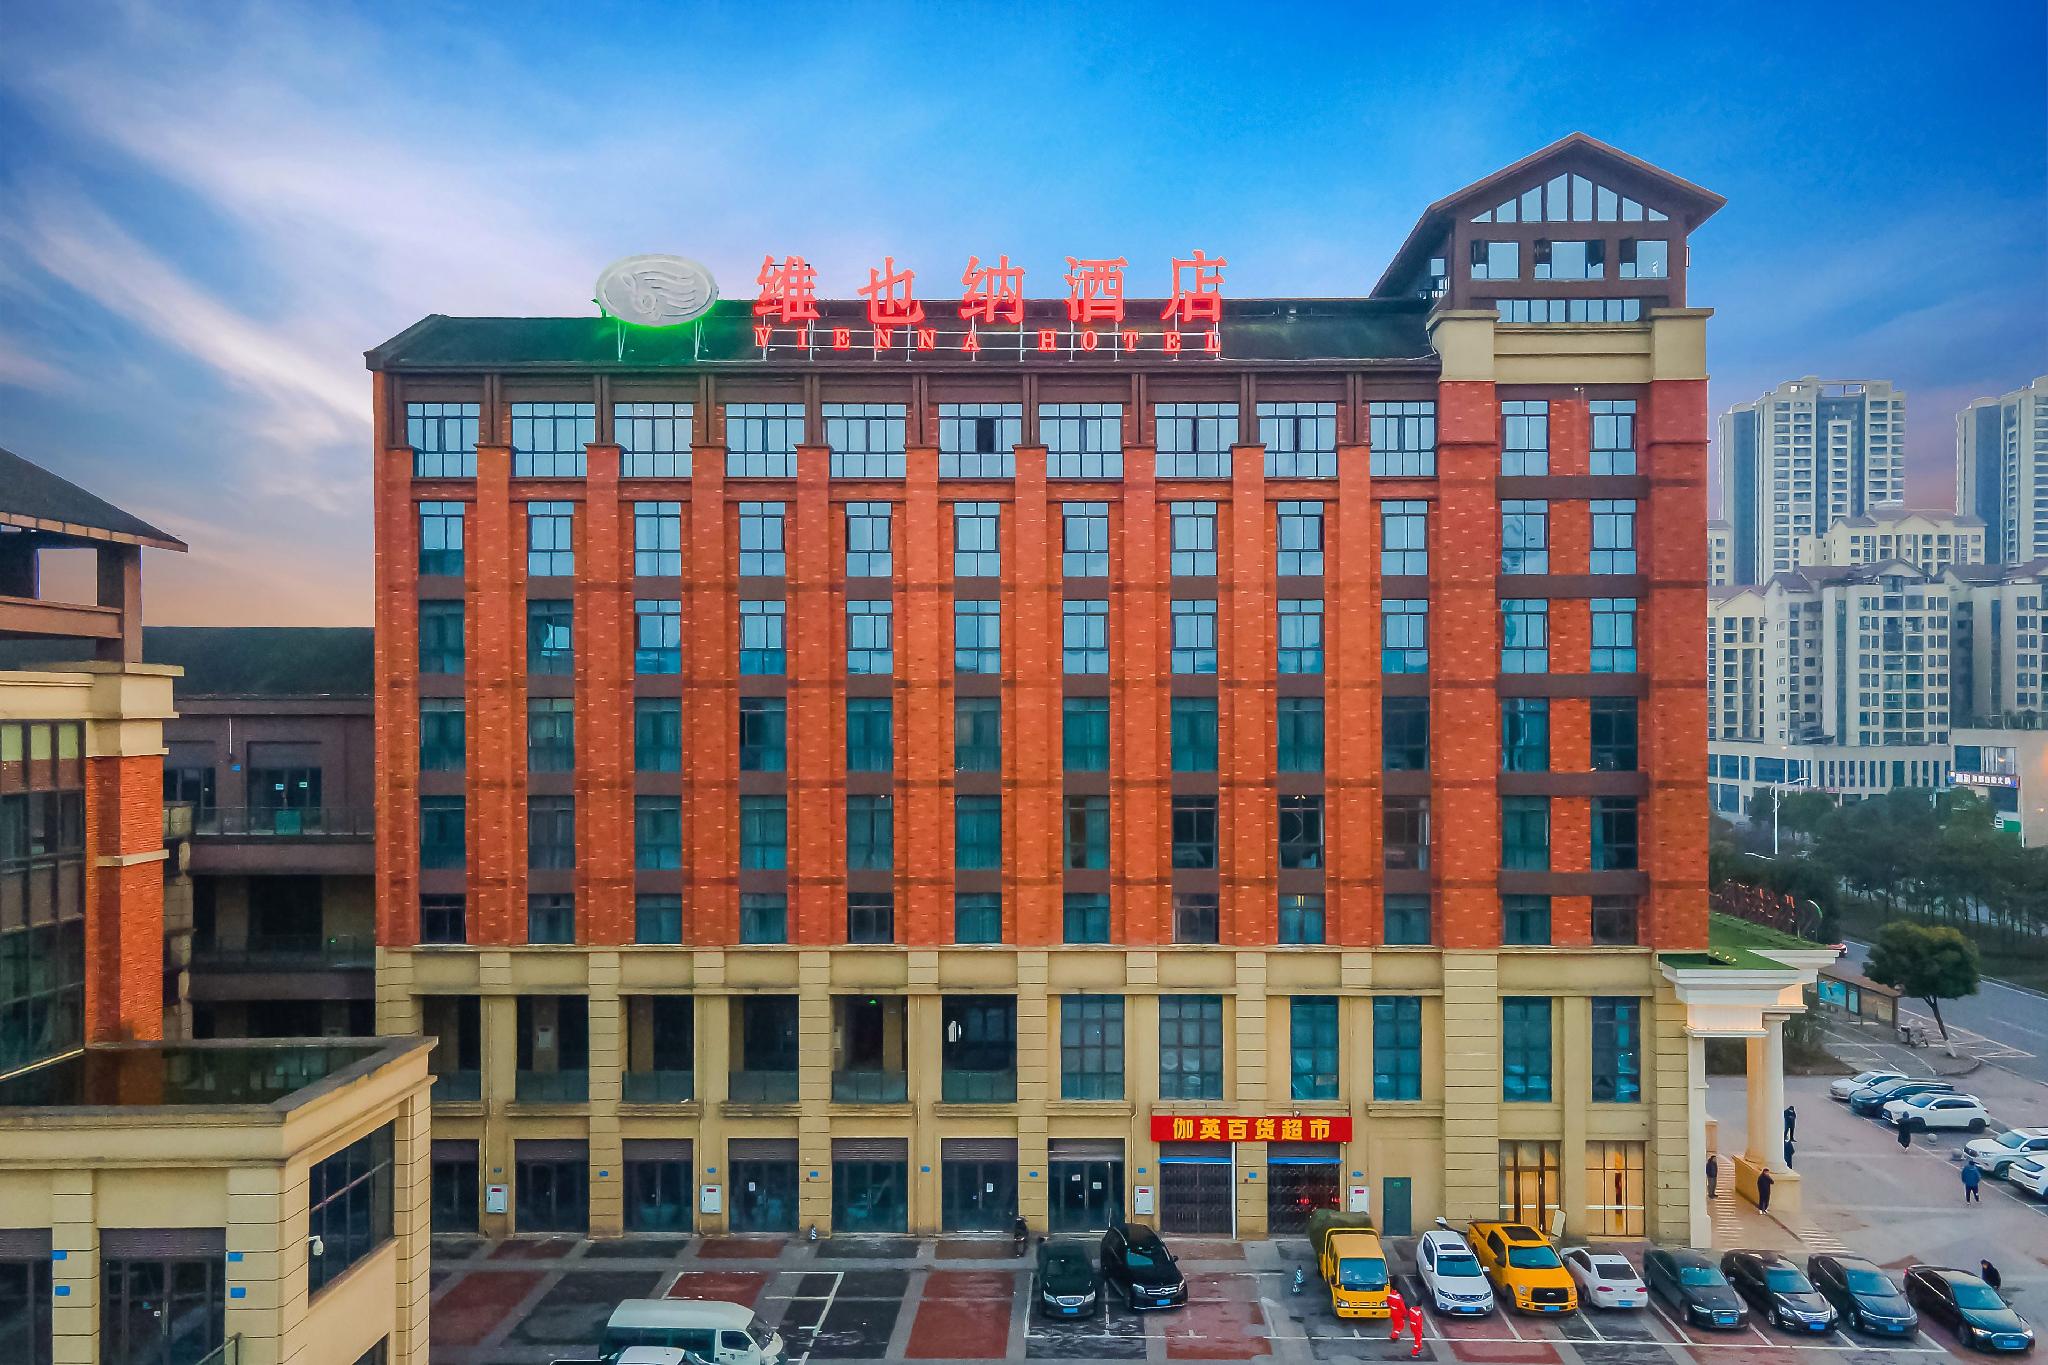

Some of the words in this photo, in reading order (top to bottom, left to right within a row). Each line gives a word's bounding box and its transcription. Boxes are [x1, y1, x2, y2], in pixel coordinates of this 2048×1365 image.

[753, 249, 1228, 323] 维也纳酒店
[754, 327, 980, 352] VIENNA
[1038, 329, 1221, 353] HOTEL
[1173, 1118, 1331, 1140] 伽英百货超市
